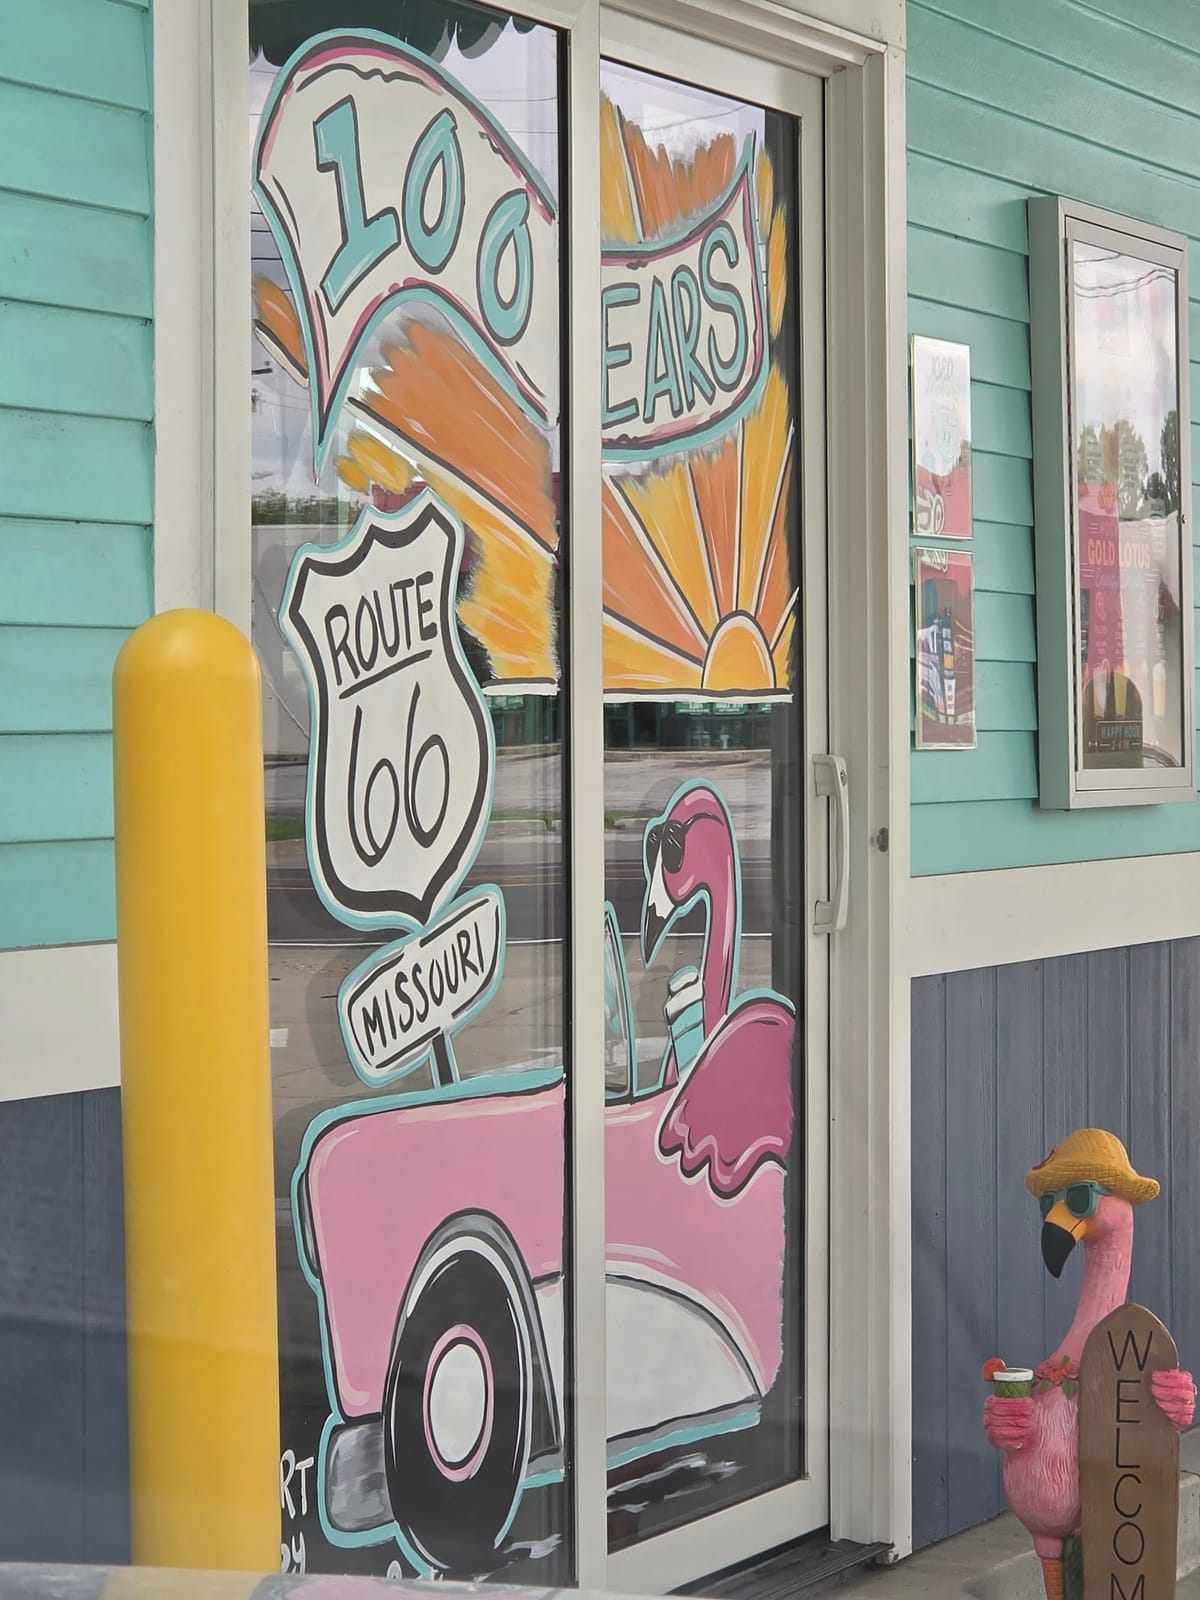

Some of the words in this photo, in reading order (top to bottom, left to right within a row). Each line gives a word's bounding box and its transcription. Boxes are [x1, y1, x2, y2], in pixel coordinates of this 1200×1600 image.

[313, 95, 534, 346] 100
[600, 220, 749, 429] EARS
[324, 571, 438, 686] ROUTE
[1087, 538, 1116, 567] GOLD
[1118, 541, 1152, 569] LOTUS
[347, 682, 450, 868] 66
[361, 921, 486, 1057] MISSOURI
[280, 1449, 315, 1520] RT
[1107, 1330, 1153, 1600] WELCOM
